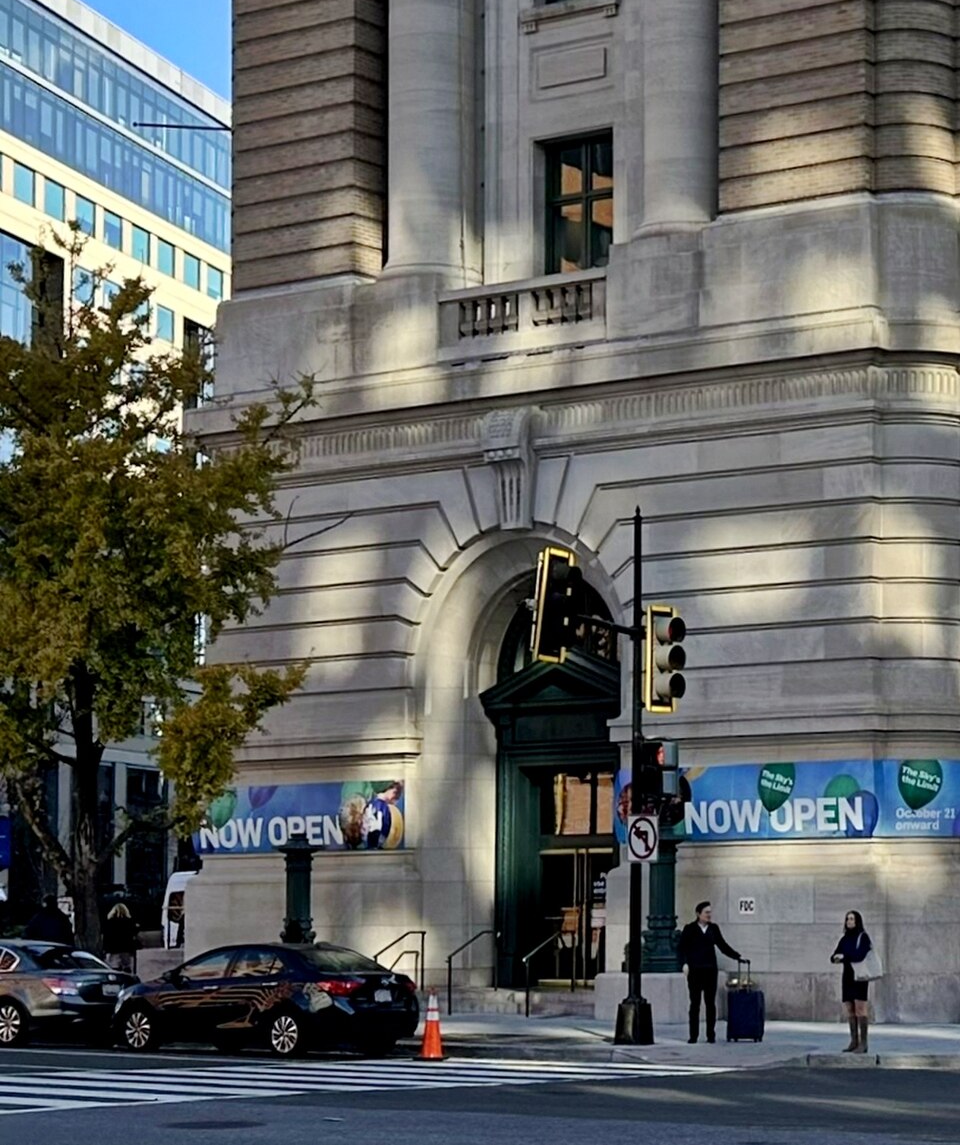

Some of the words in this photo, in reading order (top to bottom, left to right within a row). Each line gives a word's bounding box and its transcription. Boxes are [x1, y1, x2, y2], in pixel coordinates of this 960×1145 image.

[762, 769, 775, 781] The
[902, 766, 918, 777] The
[919, 770, 941, 784] Sky's
[761, 779, 773, 789] the
[772, 782, 791, 794] Limit
[902, 775, 916, 786] the
[917, 779, 940, 792] Limit
[684, 800, 763, 835] NOW
[770, 797, 864, 833] OPEN
[944, 808, 956, 819] 21
[201, 817, 263, 849] NOW
[268, 815, 344, 847] OPEN
[895, 820, 940, 831] onward
[740, 900, 754, 912] FDC
